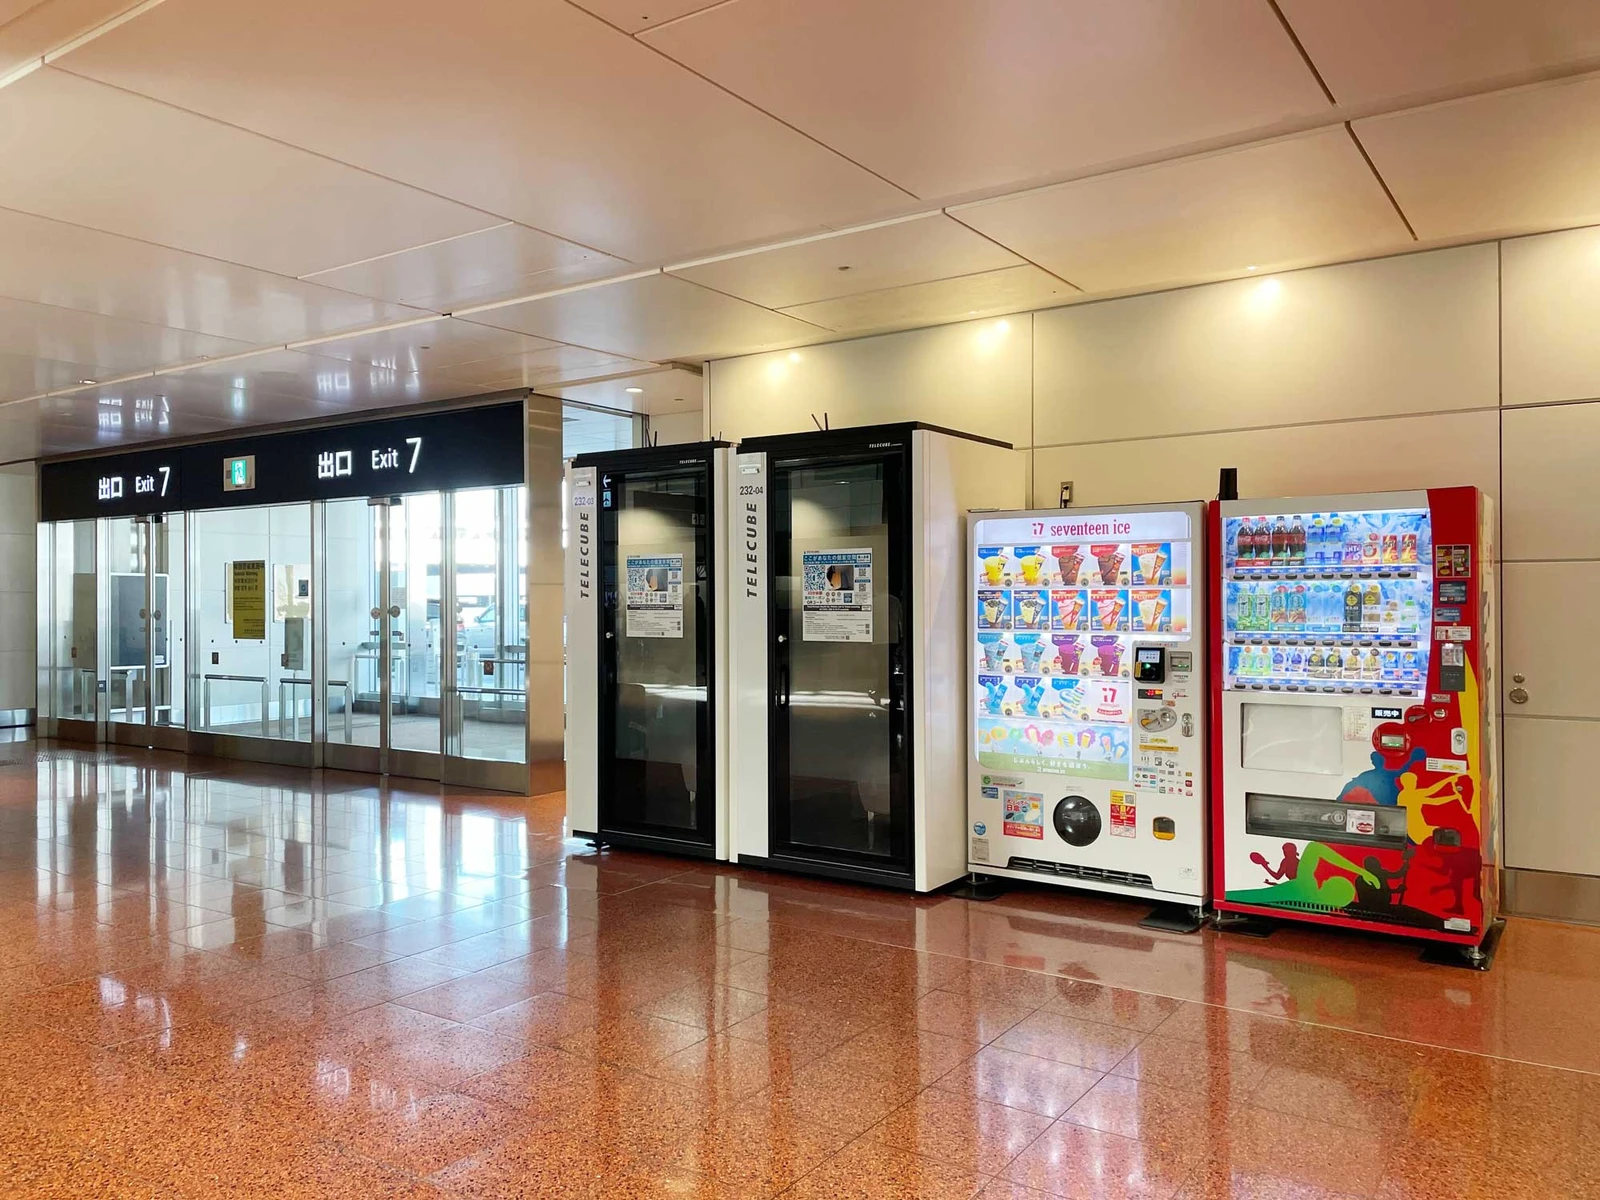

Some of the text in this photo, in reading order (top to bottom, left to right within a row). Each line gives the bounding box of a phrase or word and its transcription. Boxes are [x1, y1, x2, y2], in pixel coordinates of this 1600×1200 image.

[317, 437, 422, 479] 出口 Exit 7
[98, 466, 171, 500] 出口 Exit 7
[739, 485, 764, 496] 232-04
[574, 496, 595, 507] 232-03
[1050, 521, 1109, 537] seventeen
[1113, 518, 1131, 535] ice
[580, 512, 590, 599] TELECUBE
[746, 502, 758, 598] TELECUBE
[1374, 709, 1400, 718] 販売中
